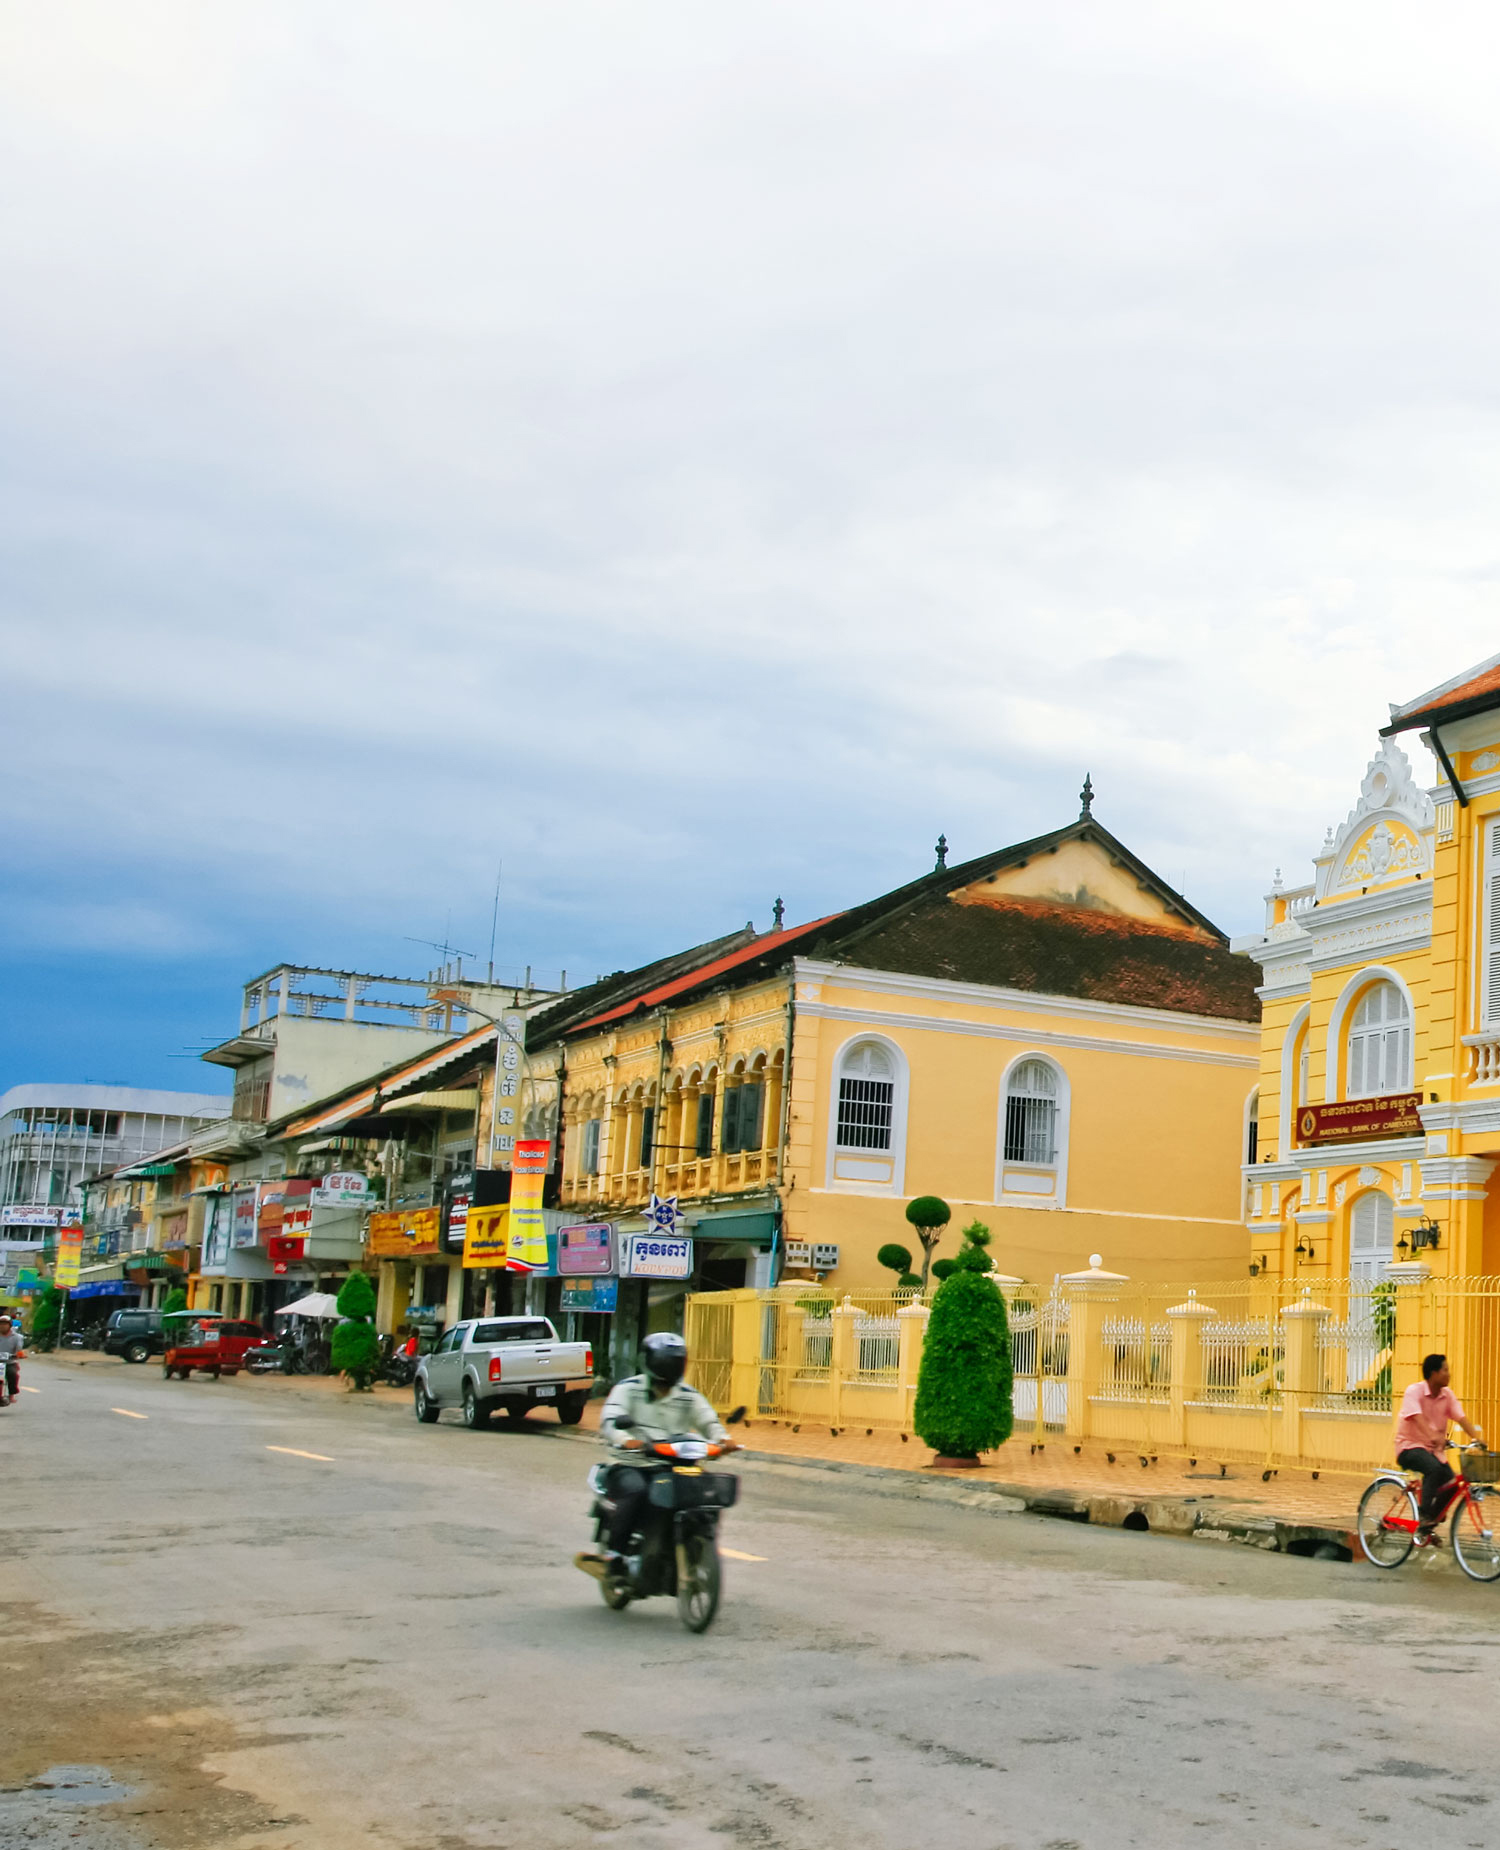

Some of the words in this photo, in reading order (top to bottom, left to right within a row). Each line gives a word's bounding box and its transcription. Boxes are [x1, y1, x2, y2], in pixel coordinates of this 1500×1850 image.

[1319, 1127, 1349, 1136] NATIONAL
[1352, 1125, 1369, 1133] BANK
[1371, 1123, 1381, 1131] OF
[1383, 1120, 1417, 1129] CAMBODIA
[635, 1241, 688, 1261] កូនពៅ
